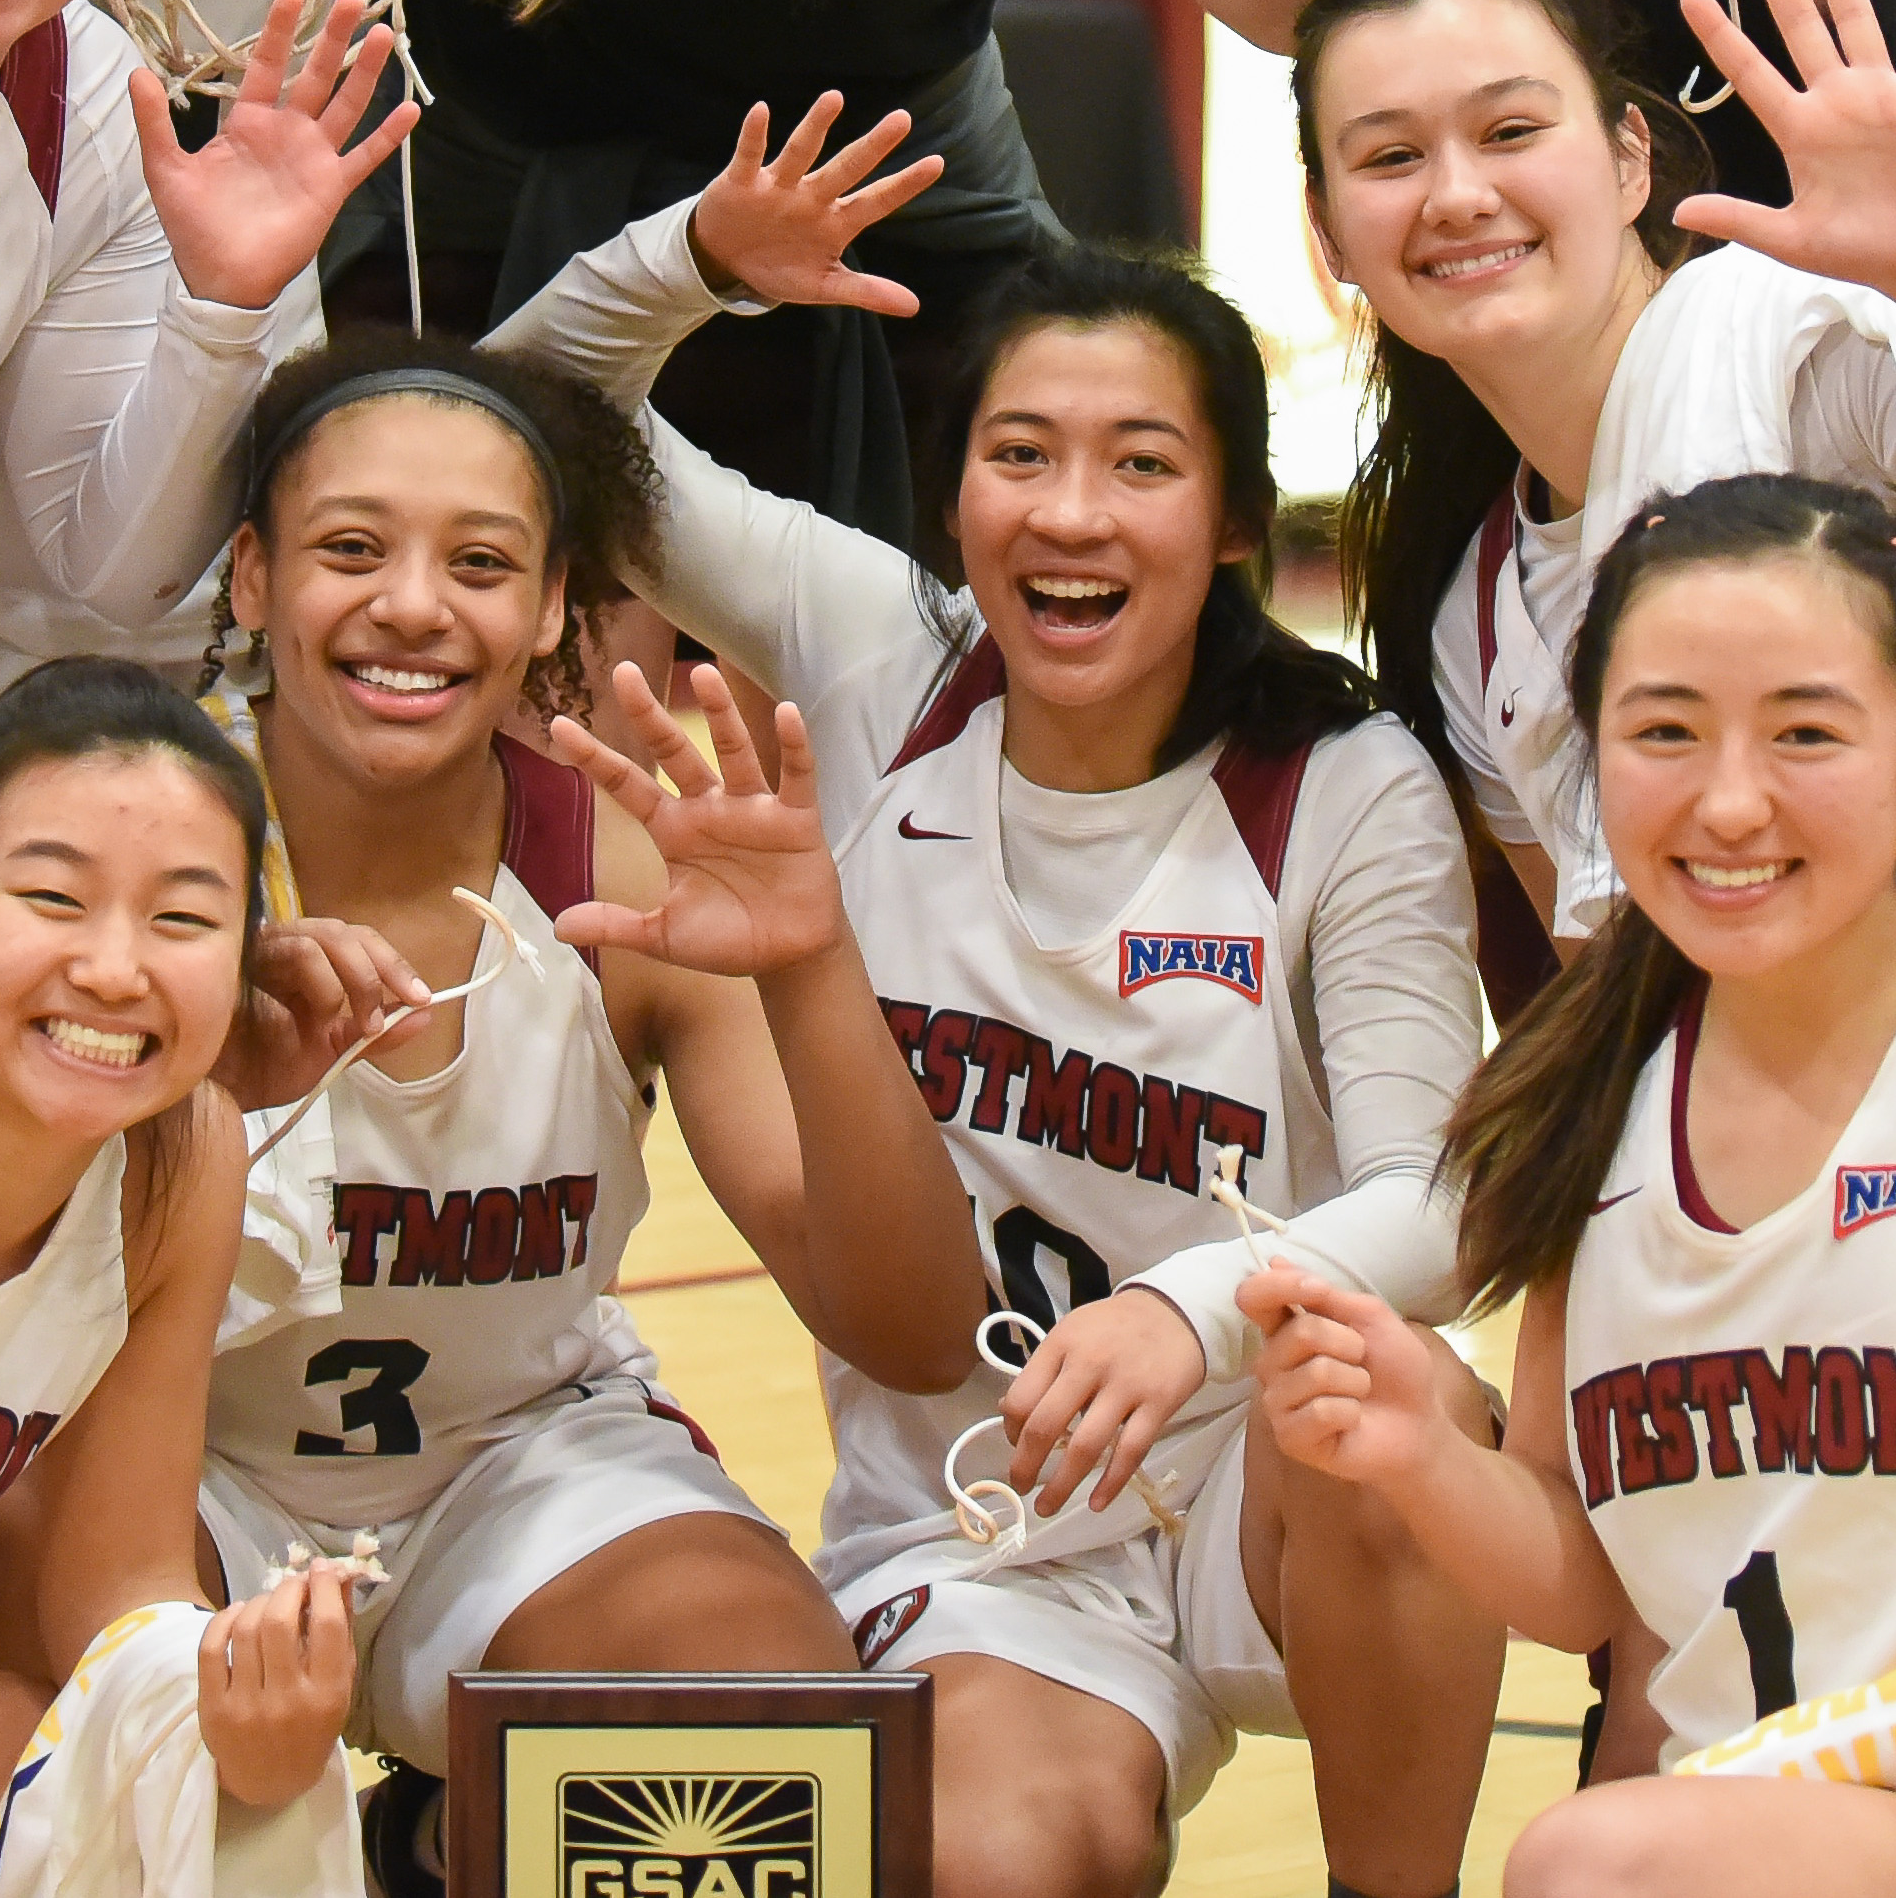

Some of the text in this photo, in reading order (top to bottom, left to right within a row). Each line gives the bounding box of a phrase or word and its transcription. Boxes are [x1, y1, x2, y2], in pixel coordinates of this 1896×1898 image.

[1126, 936, 1259, 988] NAIA
[968, 1197, 1113, 1369] 0
[293, 1337, 433, 1456] 3
[1722, 1549, 1797, 1726] 1
[570, 1858, 807, 1898] GSAC
